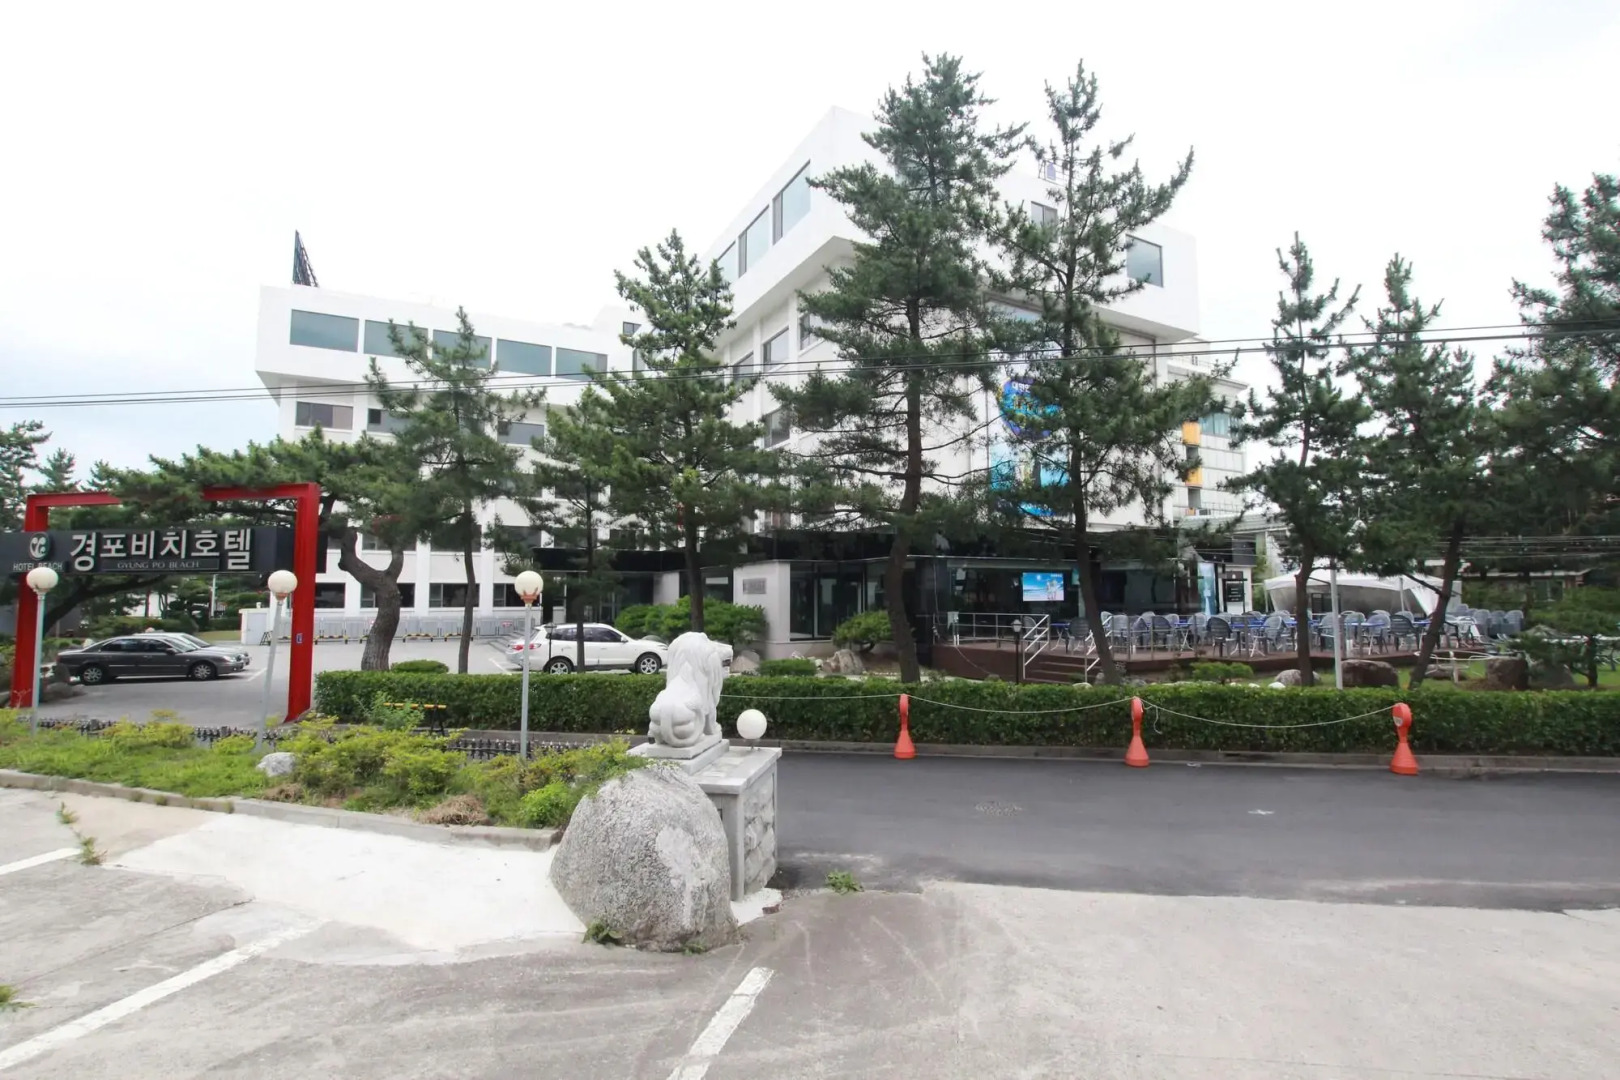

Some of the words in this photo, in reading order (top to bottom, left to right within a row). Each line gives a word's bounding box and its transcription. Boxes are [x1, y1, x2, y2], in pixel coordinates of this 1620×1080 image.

[70, 528, 250, 572] 경포비치호텔
[117, 561, 149, 569] GYUNG
[152, 561, 166, 569] PO
[169, 560, 199, 569] BEACH
